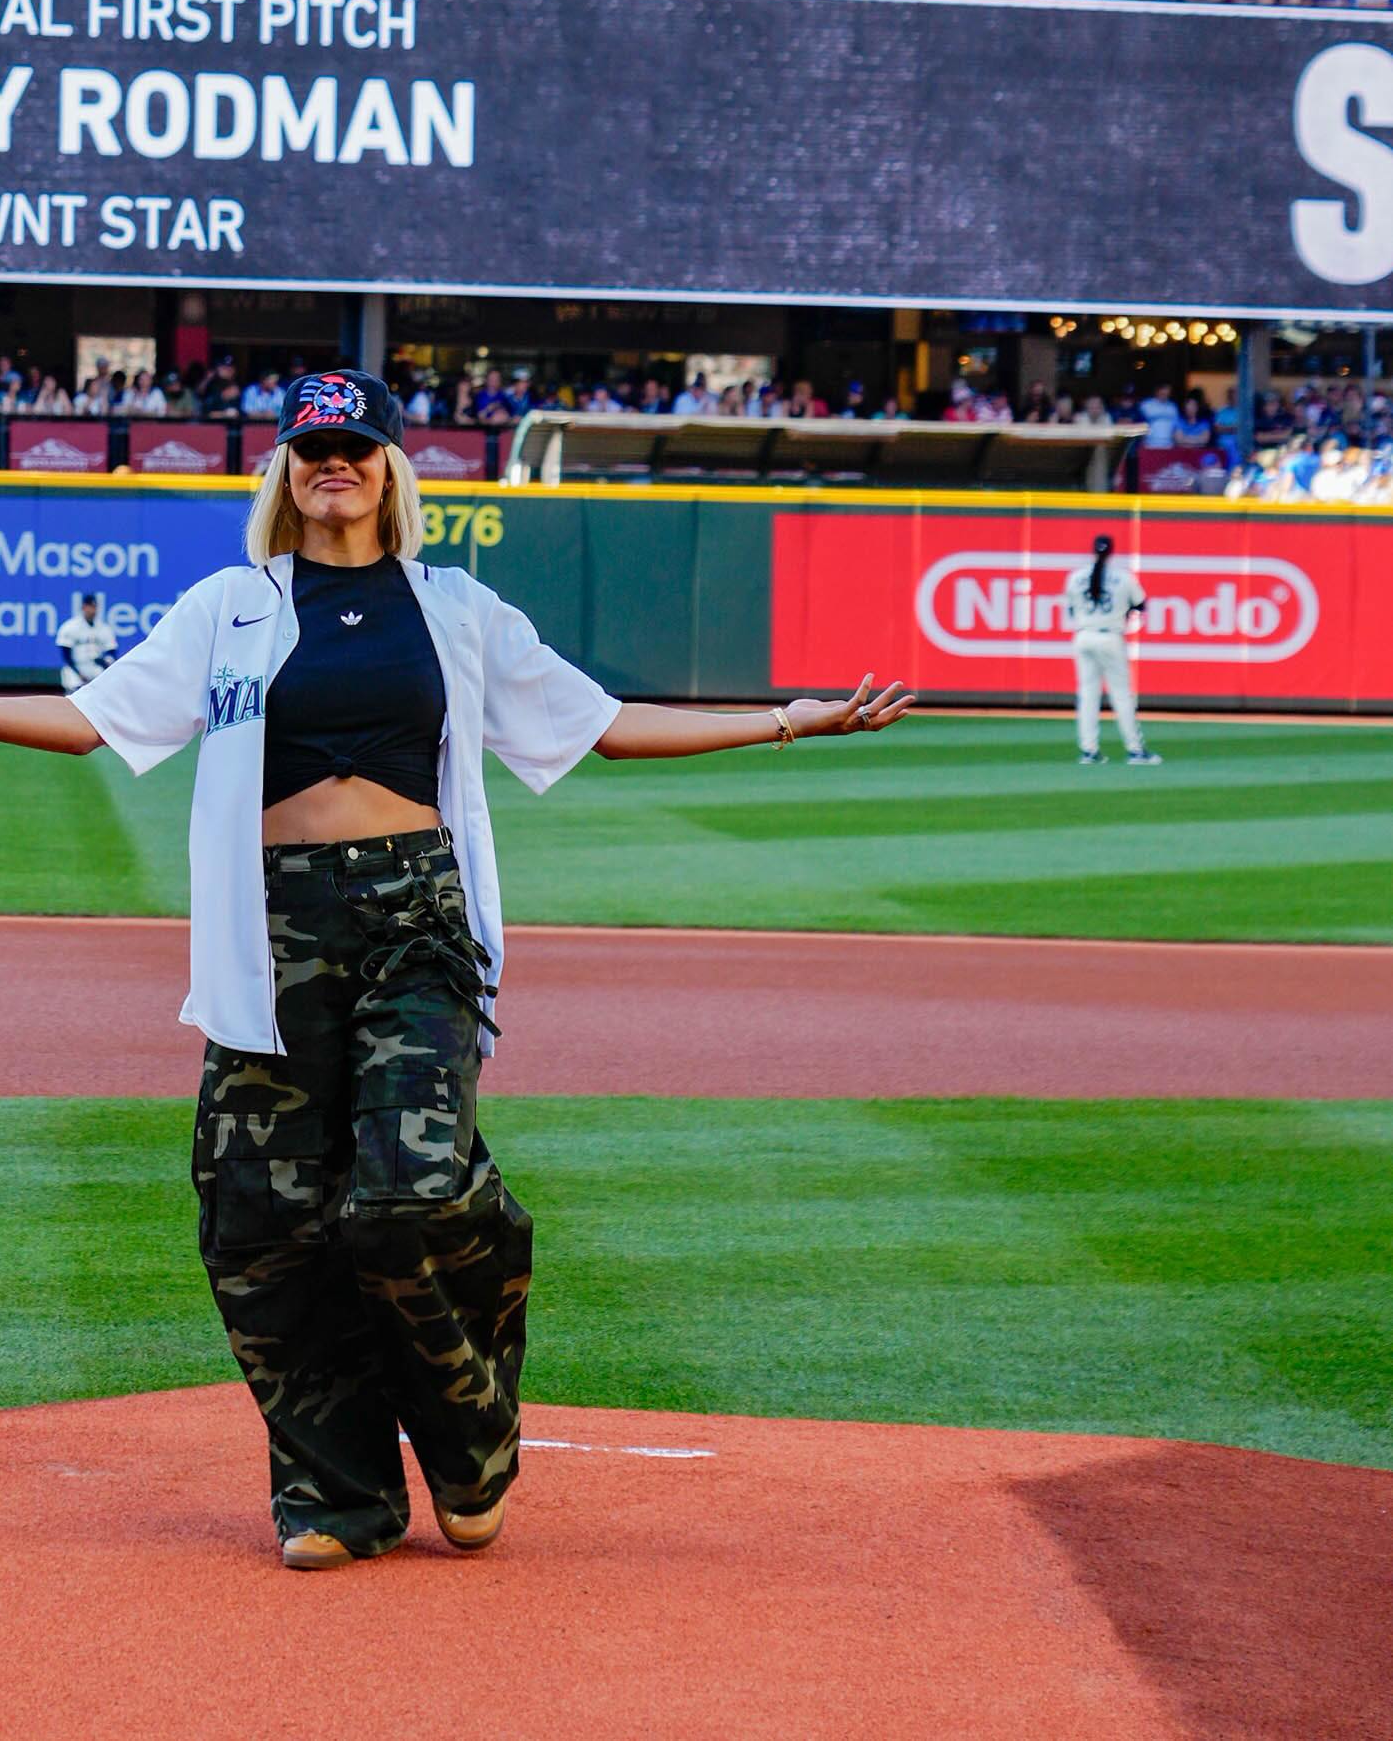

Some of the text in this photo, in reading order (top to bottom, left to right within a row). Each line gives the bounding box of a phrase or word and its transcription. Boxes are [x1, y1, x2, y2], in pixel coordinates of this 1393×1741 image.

[58, 67, 475, 168] RODMAN
[99, 195, 245, 253] STAR
[345, 381, 367, 420] adidas
[421, 502, 504, 547] 376
[954, 577, 1280, 638] Ninndo
